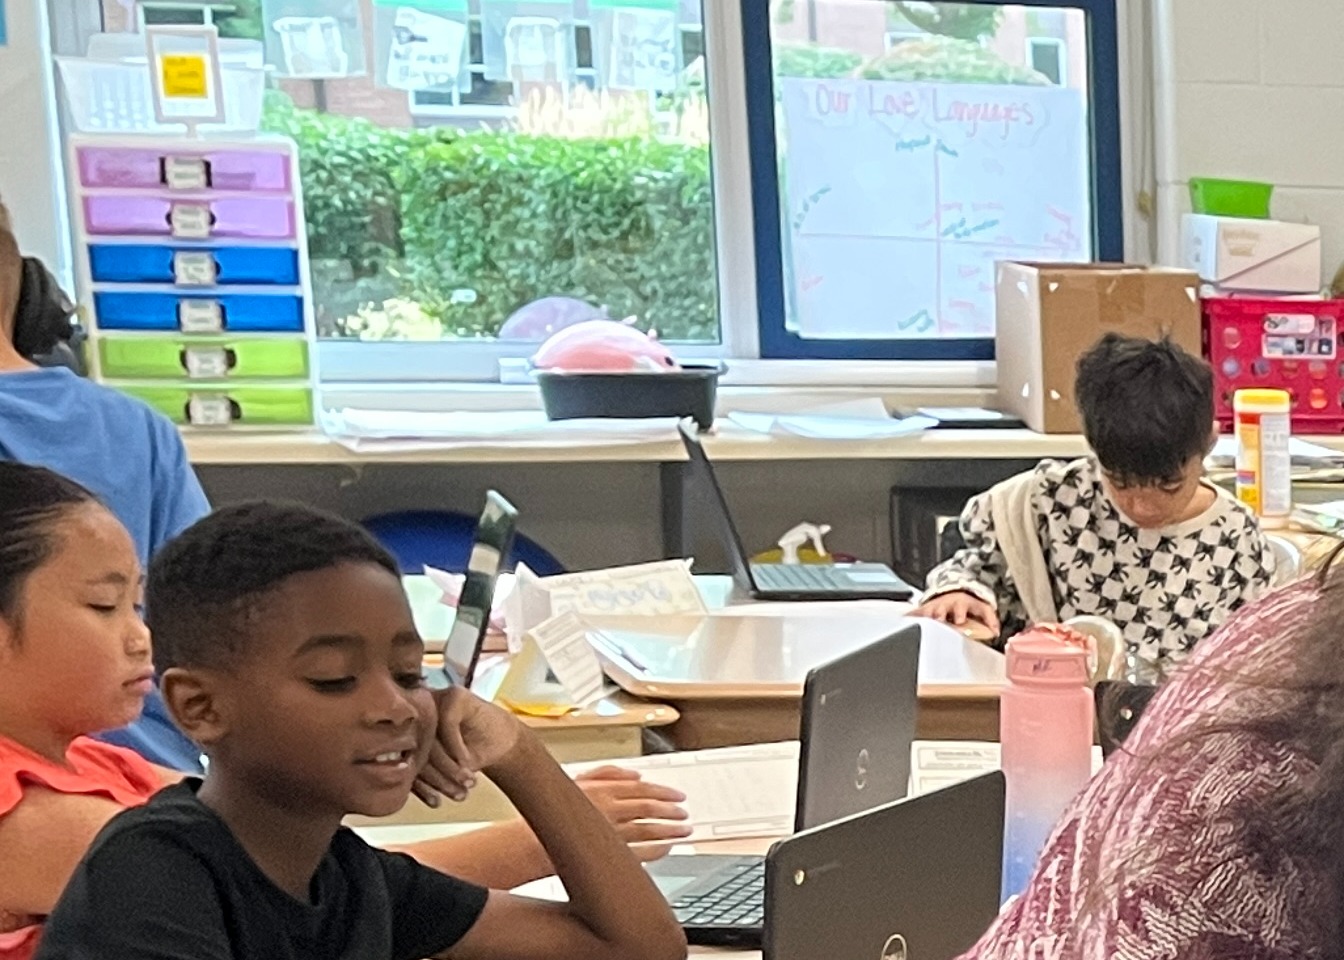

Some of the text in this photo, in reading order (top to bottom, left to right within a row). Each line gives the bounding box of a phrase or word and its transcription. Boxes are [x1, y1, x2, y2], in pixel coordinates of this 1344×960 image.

[815, 82, 1035, 140] Our Love Languages
